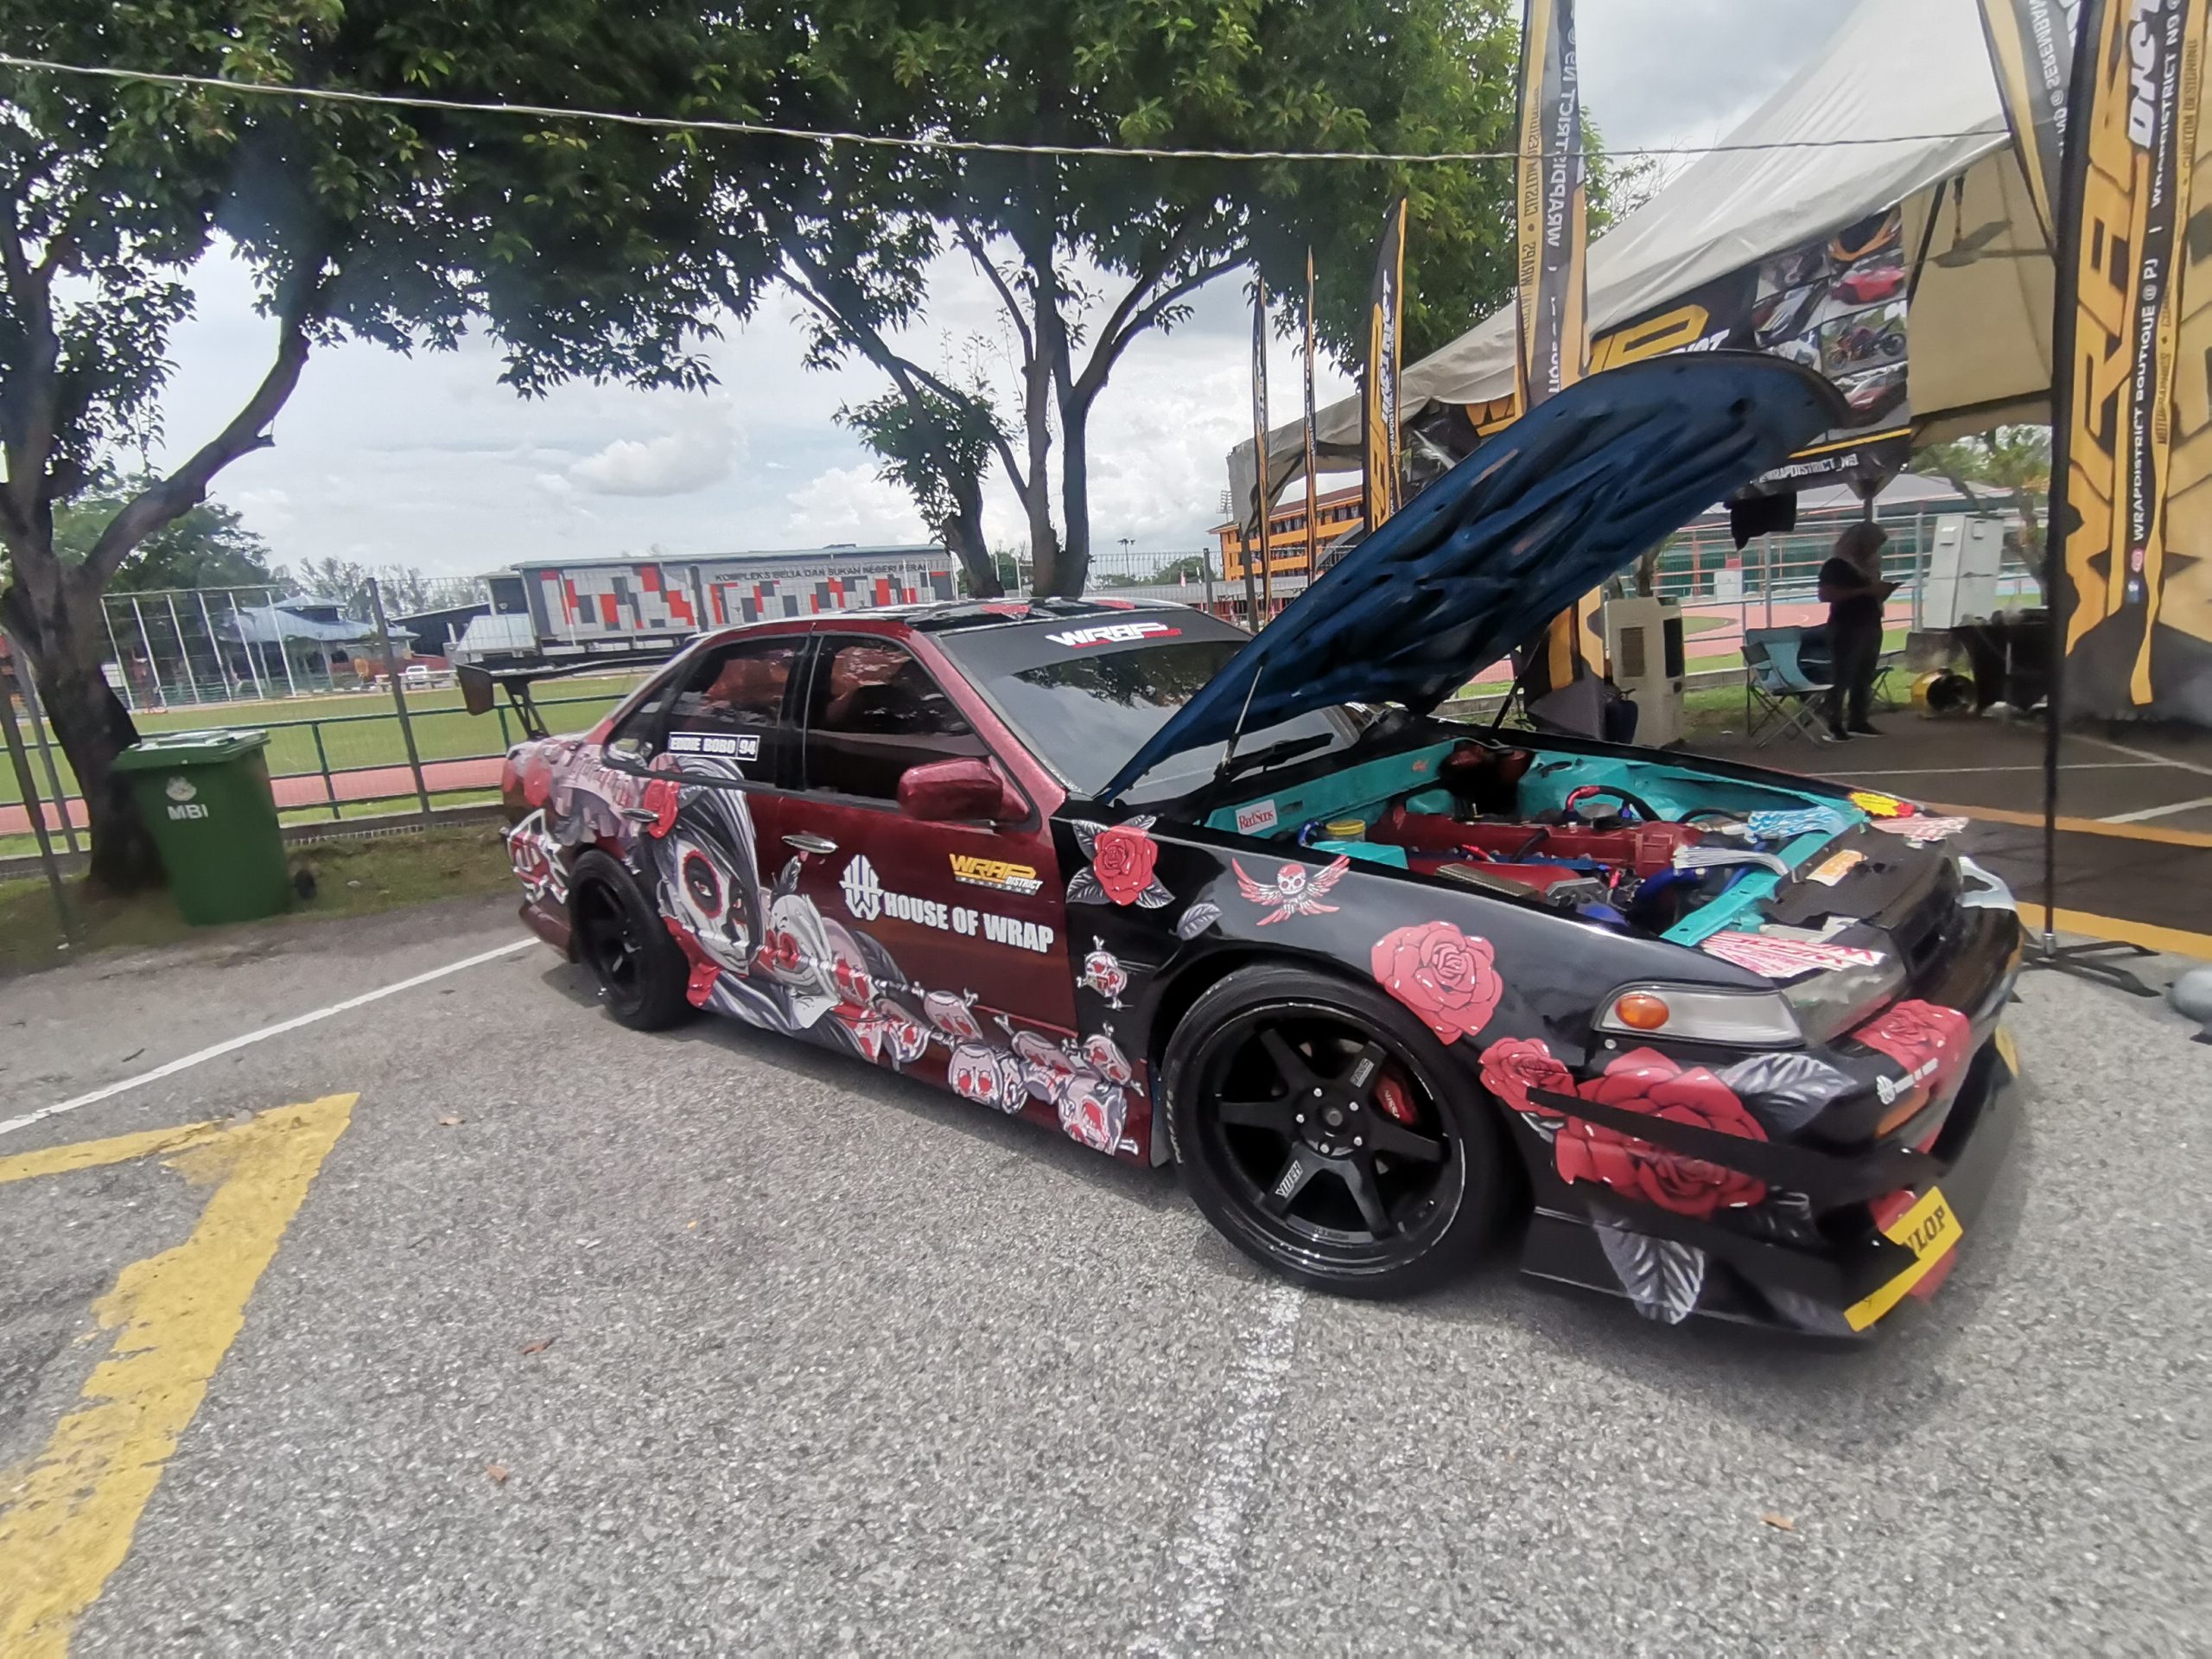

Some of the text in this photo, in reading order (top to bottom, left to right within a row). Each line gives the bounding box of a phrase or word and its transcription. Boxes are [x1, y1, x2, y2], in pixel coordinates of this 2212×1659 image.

[2143, 258, 2159, 281] PJ
[804, 568, 825, 577] DAN
[828, 566, 861, 576] SUKAN
[1045, 622, 1168, 647] WRAP
[739, 740, 757, 755] 94
[167, 804, 209, 821] MBI
[950, 853, 1037, 883] WRAP
[1004, 875, 1044, 890] DISTRICT
[883, 891, 1055, 954] HOUSE OF WRAP
